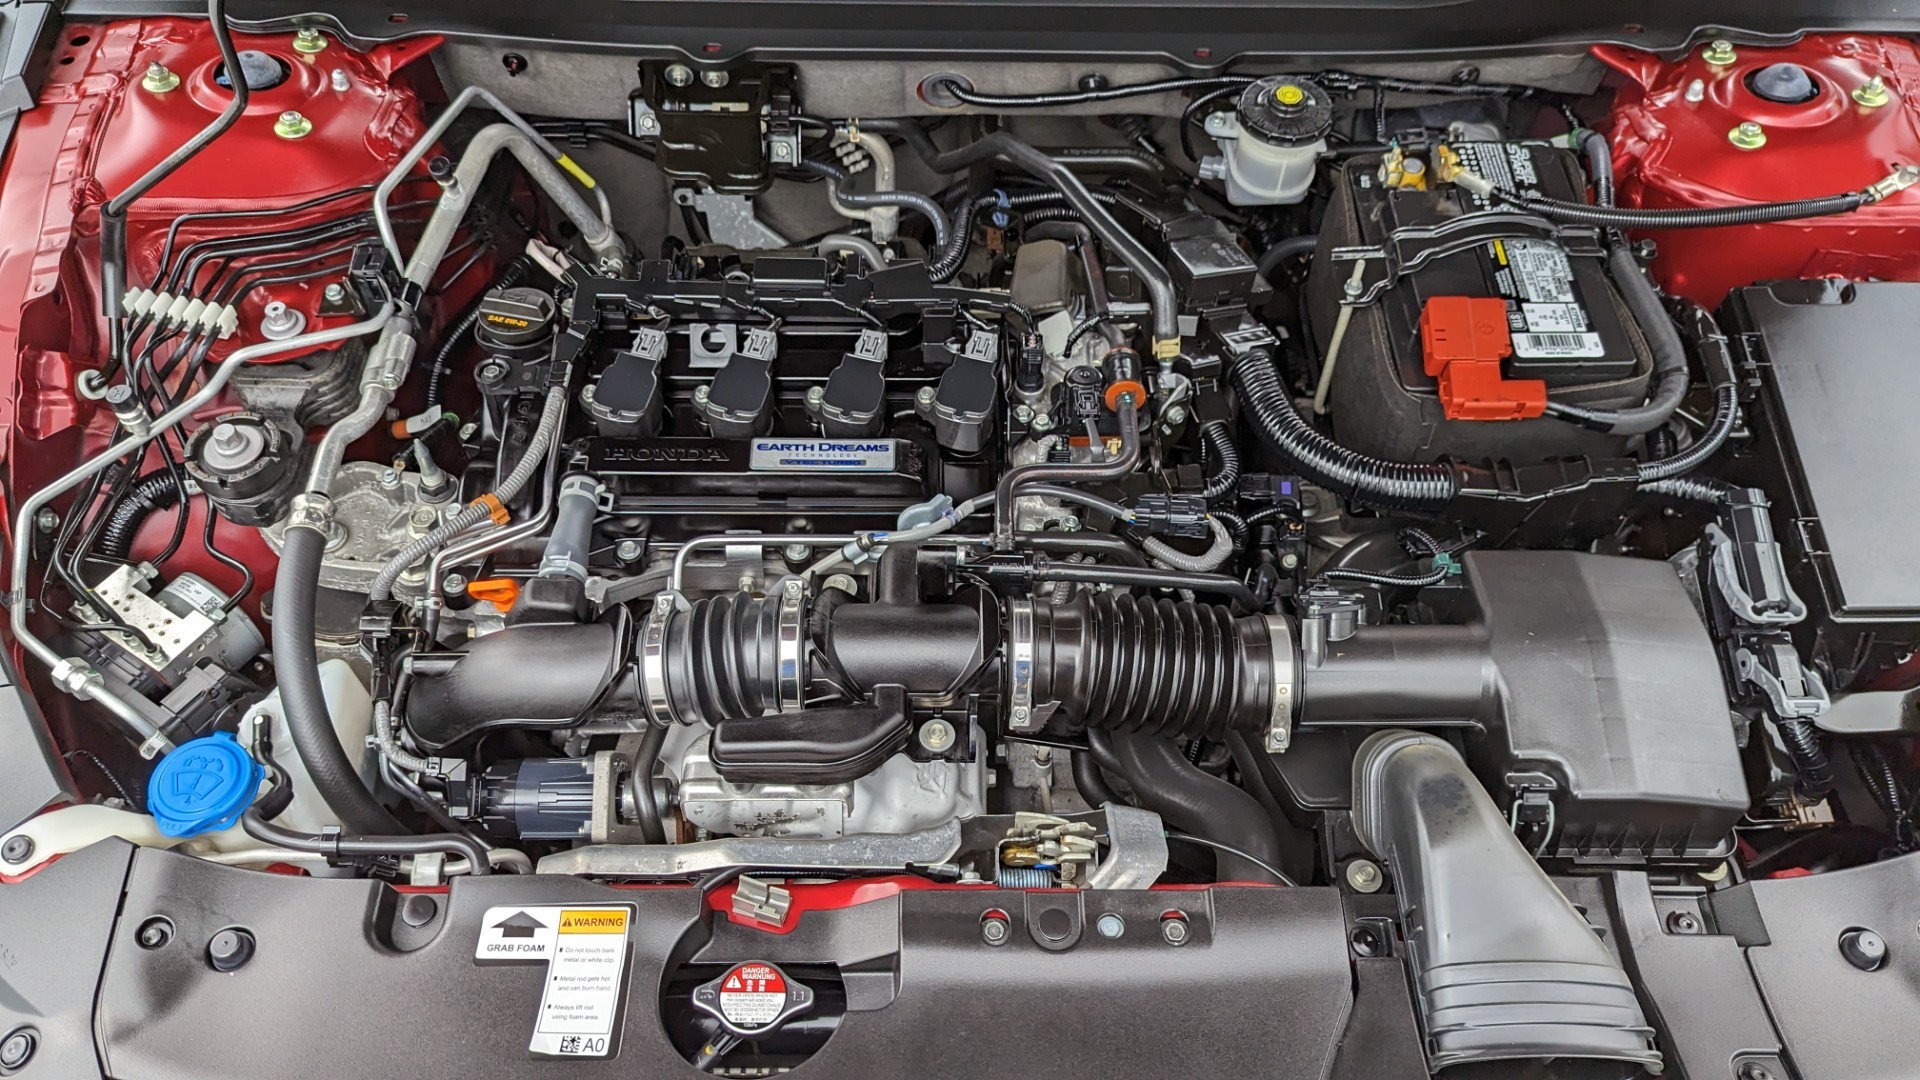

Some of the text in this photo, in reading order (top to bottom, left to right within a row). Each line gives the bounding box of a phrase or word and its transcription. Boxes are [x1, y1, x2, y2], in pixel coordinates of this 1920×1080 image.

[1520, 148, 1537, 184] SUPER
[487, 315, 505, 323] SAE
[757, 443, 815, 451] EARTH
[604, 448, 730, 461] HONDA
[574, 918, 624, 927] WARNING
[487, 944, 545, 953] GRAB FOAM
[587, 976, 600, 984] gets
[792, 991, 805, 1002] 1.1
[553, 1004, 574, 1013] Always
[552, 1014, 567, 1022] using
